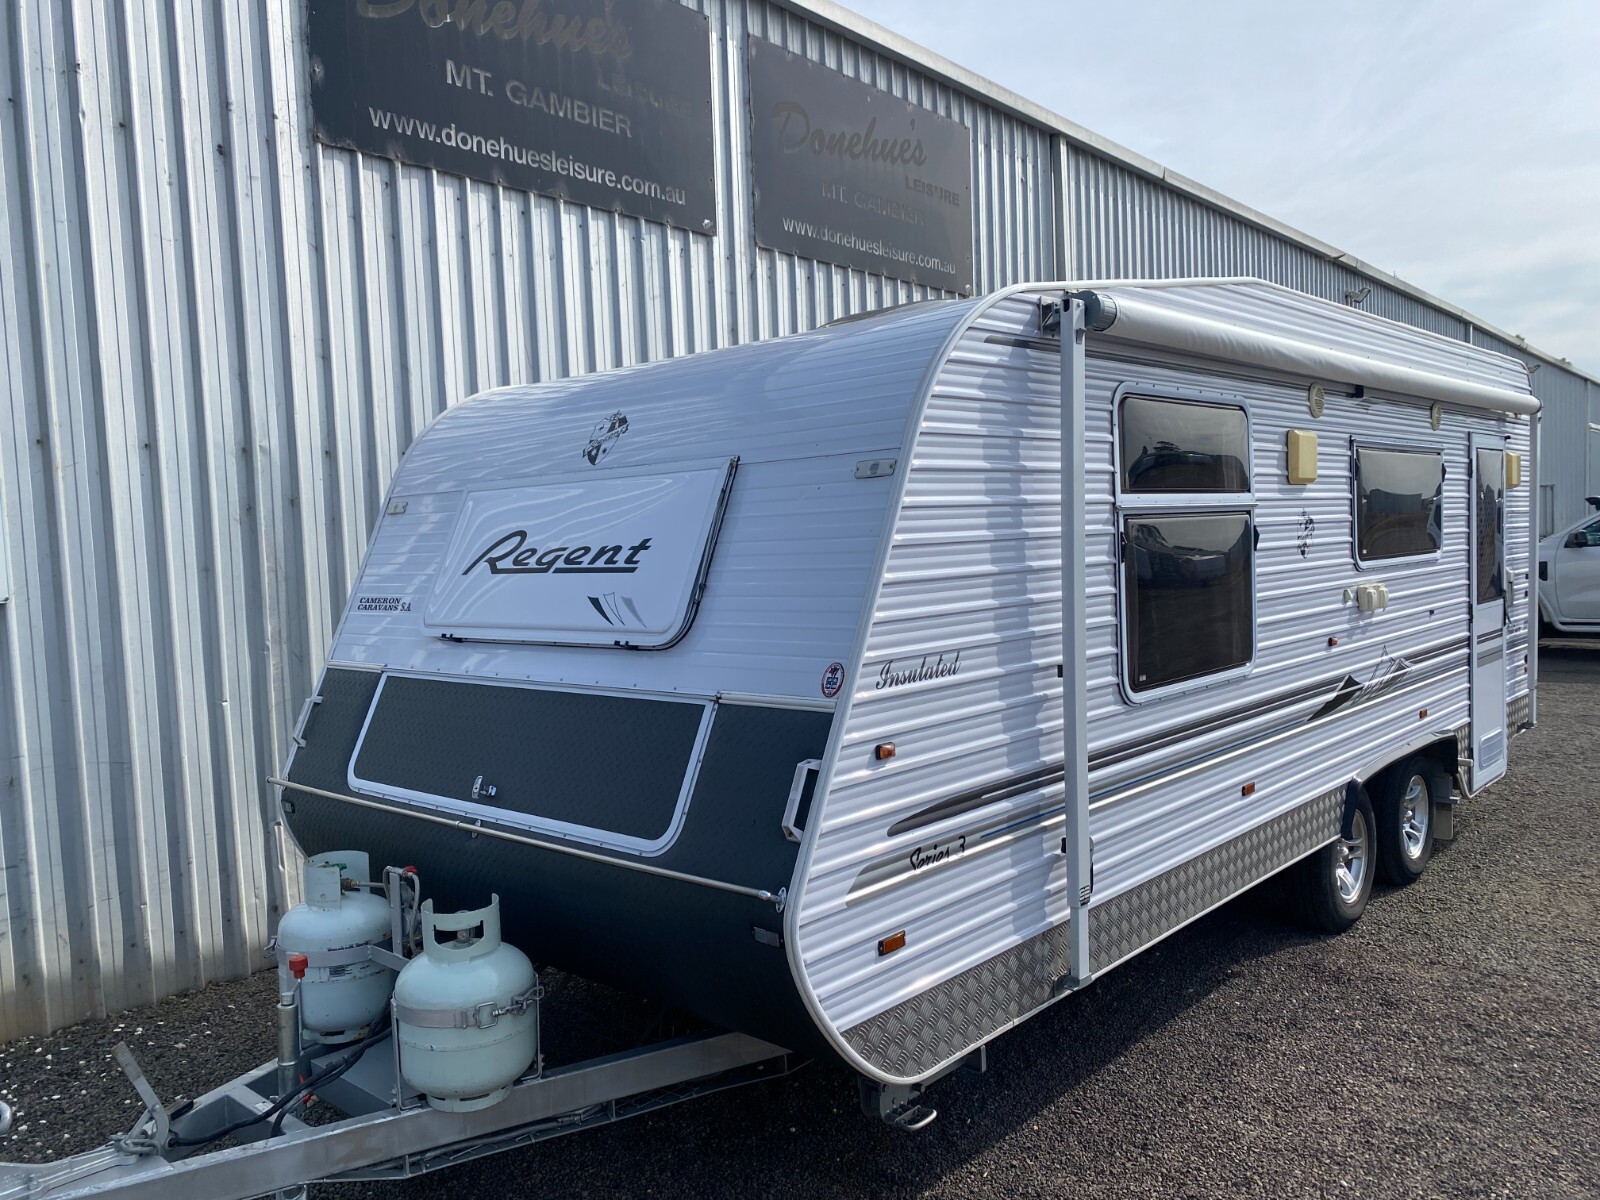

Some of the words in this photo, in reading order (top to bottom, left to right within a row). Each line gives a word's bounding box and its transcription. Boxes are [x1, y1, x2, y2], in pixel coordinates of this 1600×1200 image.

[446, 59, 494, 96] MT.
[505, 80, 632, 138] GAMBIER
[772, 100, 928, 167] Donehue's
[368, 106, 686, 206] www.donehuesleisure.com.au
[905, 174, 961, 207] LEISURE
[782, 215, 957, 275] www.donehuesleisure.com.au
[462, 529, 653, 576] Regent
[357, 603, 400, 612] CARAVANS
[359, 597, 402, 605] CAMERON
[876, 650, 962, 690] Insulated
[957, 835, 967, 857] 3
